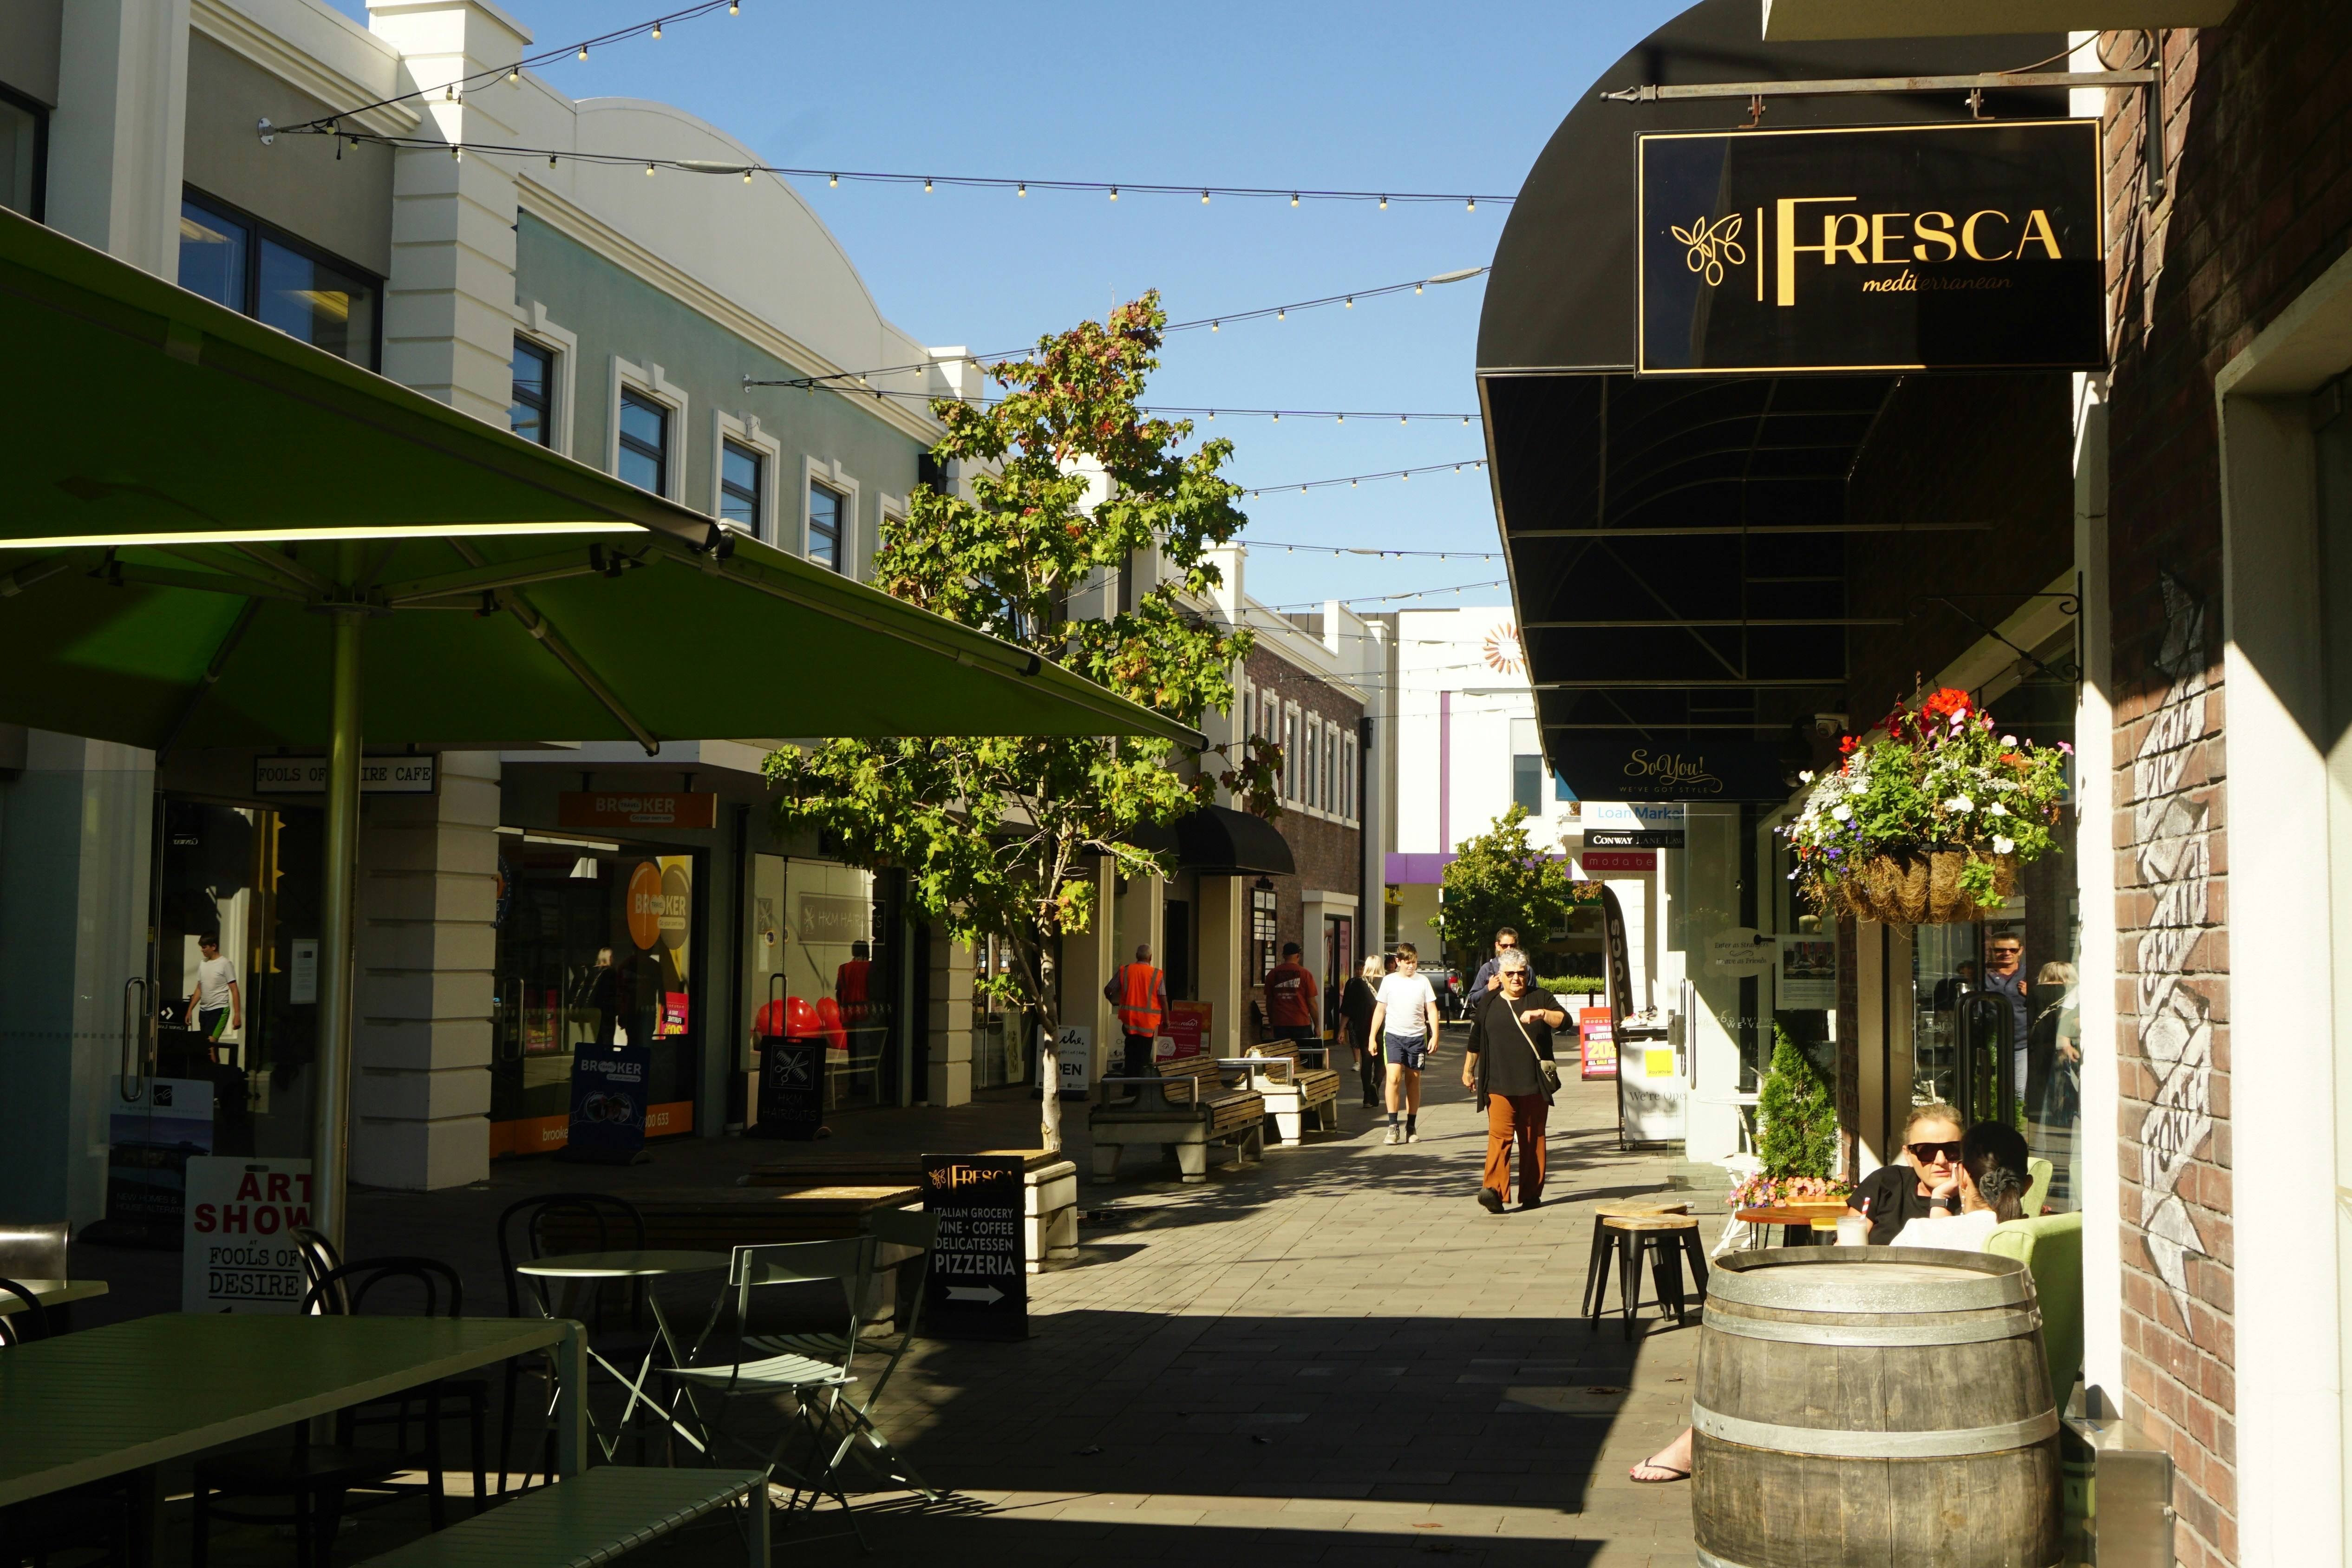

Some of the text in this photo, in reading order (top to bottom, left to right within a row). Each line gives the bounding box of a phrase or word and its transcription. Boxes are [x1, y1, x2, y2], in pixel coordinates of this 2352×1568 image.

[1777, 196, 2062, 306] FRESCA
[1863, 268, 2013, 292] mediterranean
[258, 767, 431, 781] FOOLS OF IRE CAFE
[596, 797, 675, 813] BROOKER
[1598, 807, 1631, 818] Loan
[1593, 835, 1633, 844] CONWAY
[1666, 836, 1685, 844] LAW
[1589, 857, 1653, 866] moda be
[635, 893, 686, 916] BROOKER
[818, 910, 839, 927] HKM
[1059, 1030, 1084, 1045] che.
[1588, 1041, 1617, 1058] 20%
[581, 1059, 642, 1075] BROOKER
[1059, 1063, 1082, 1076] EN
[777, 1092, 803, 1105] HKM
[1629, 1091, 1686, 1102] We're Ope
[657, 1112, 669, 1126] 633
[763, 1107, 817, 1122] HAIRCUTS
[542, 1125, 569, 1142] brooke
[235, 1172, 312, 1203] ART
[952, 1165, 1015, 1195] FRESCA
[116, 1192, 137, 1201] NEW
[139, 1194, 169, 1204] HOMES
[116, 1202, 185, 1215] HOUSE ALTERATIO
[933, 1207, 1014, 1219] ITALIAN GROCERY
[194, 1204, 311, 1235] SHOW
[973, 1221, 1014, 1235] COFFEE
[935, 1237, 1013, 1251] DELICATESSEN
[209, 1247, 300, 1267] FOOLS OF
[935, 1254, 1016, 1276] PIZZERIA
[209, 1272, 299, 1296] DESIRE
